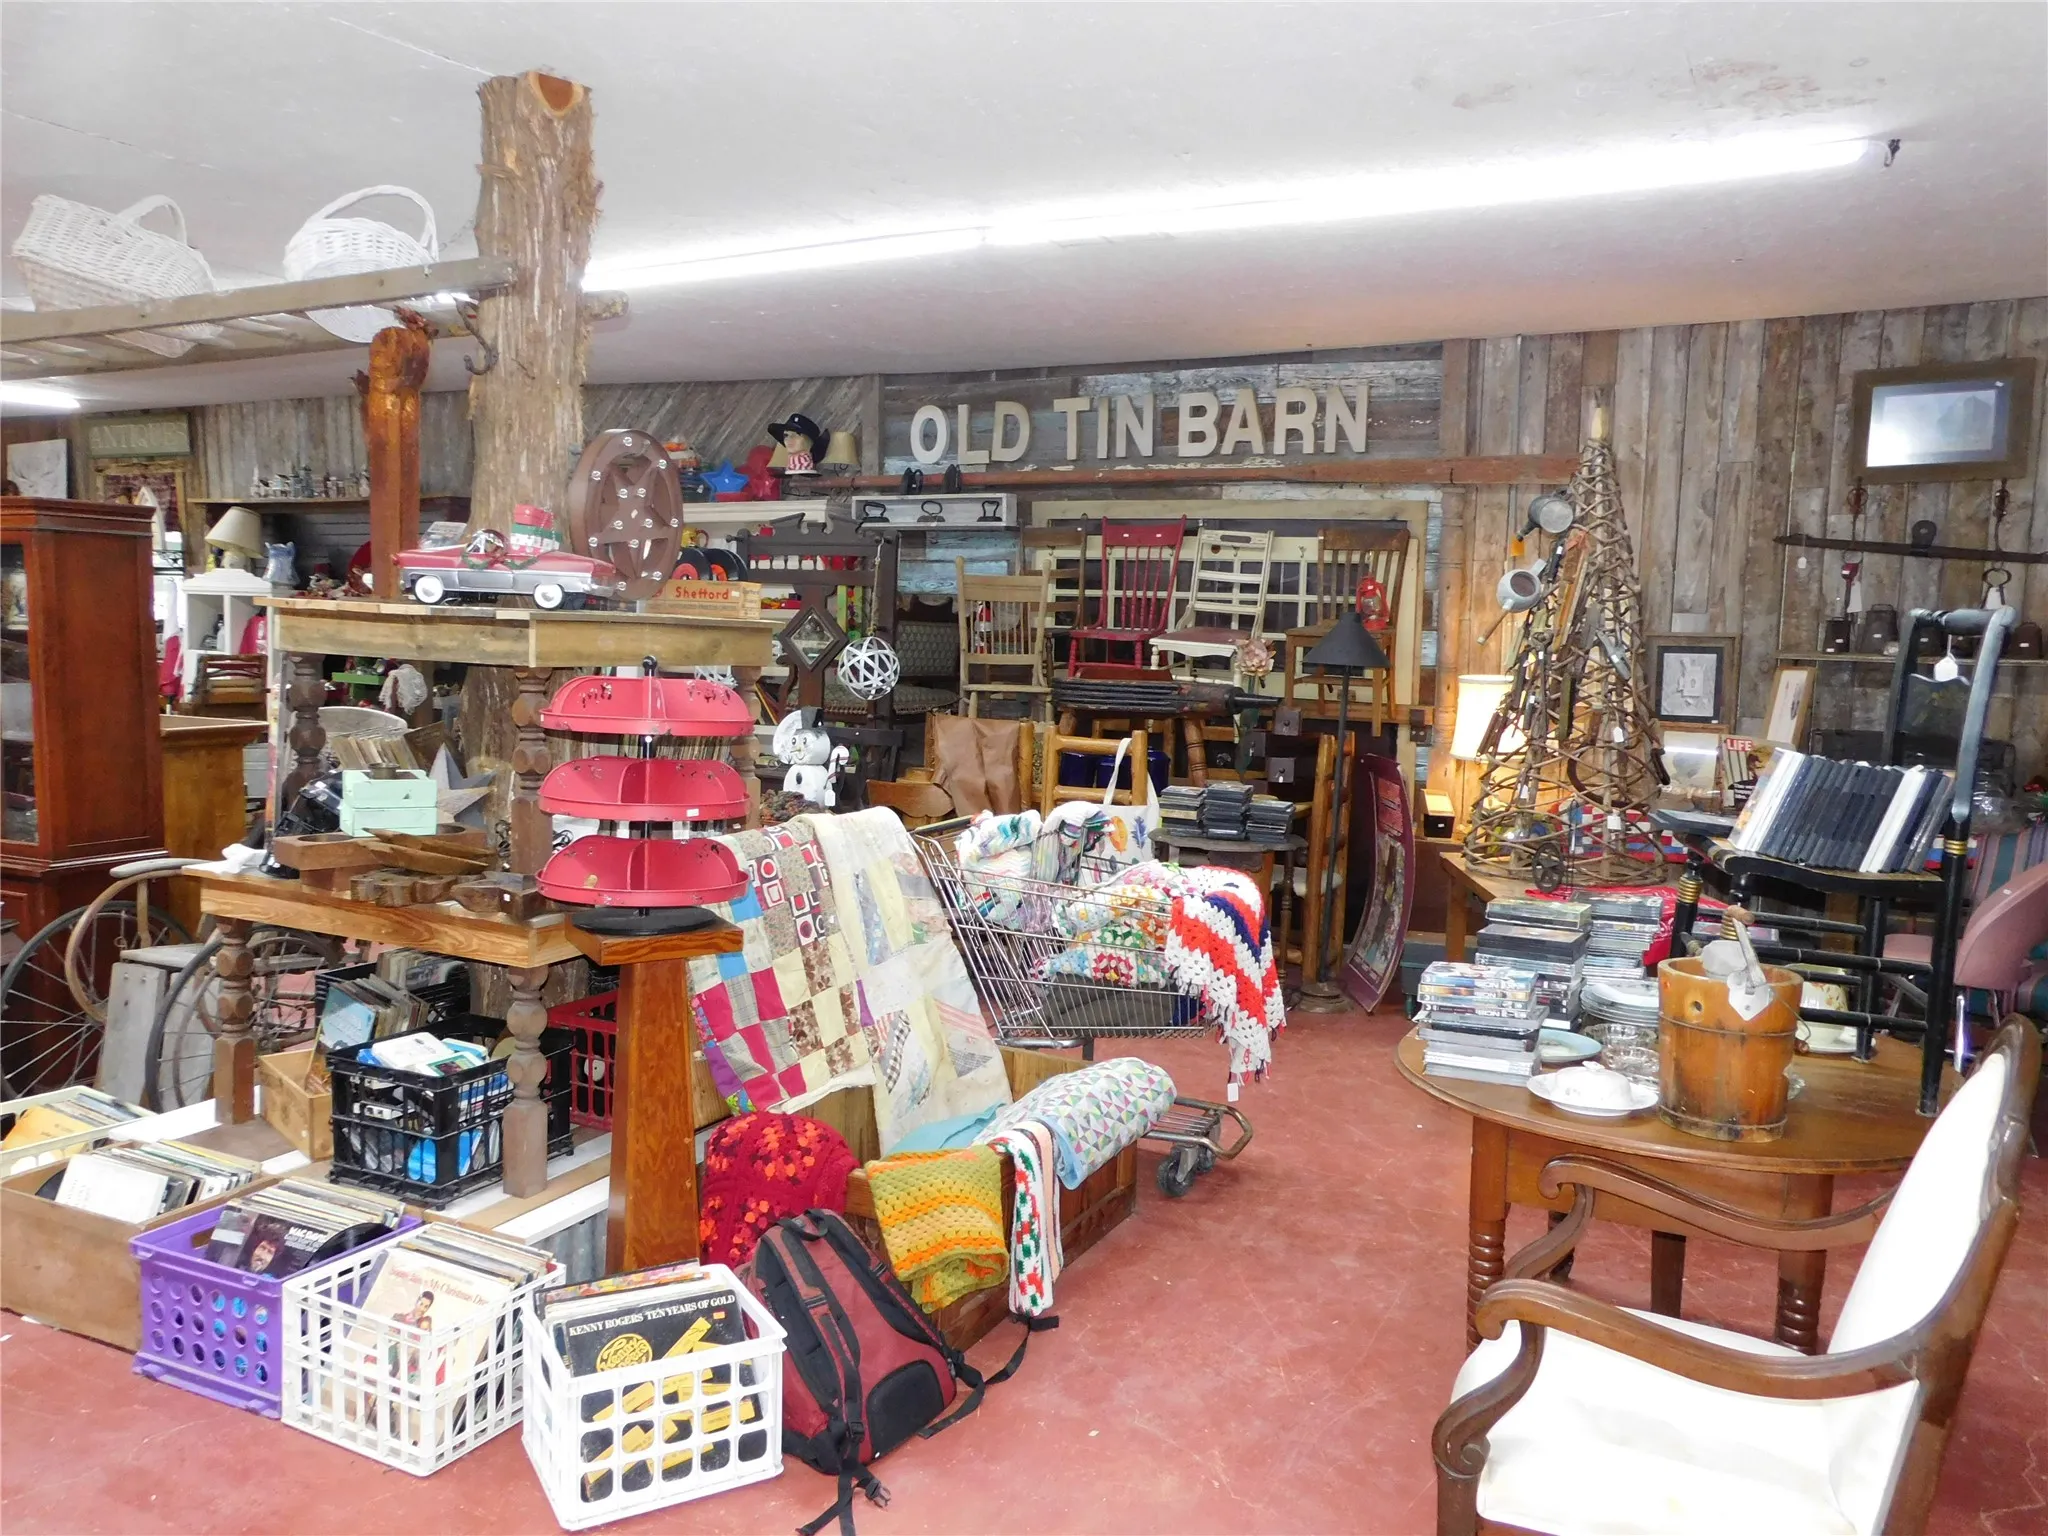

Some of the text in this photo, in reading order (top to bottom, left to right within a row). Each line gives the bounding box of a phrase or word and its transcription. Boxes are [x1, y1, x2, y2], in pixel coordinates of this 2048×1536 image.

[89, 421, 188, 449] ANTIQUES
[910, 384, 1370, 466] OLD TIN BARN
[1726, 738, 1753, 752] LIFE
[569, 1294, 736, 1337] KENNY ROGERS TEN YEARS OF GOLD
